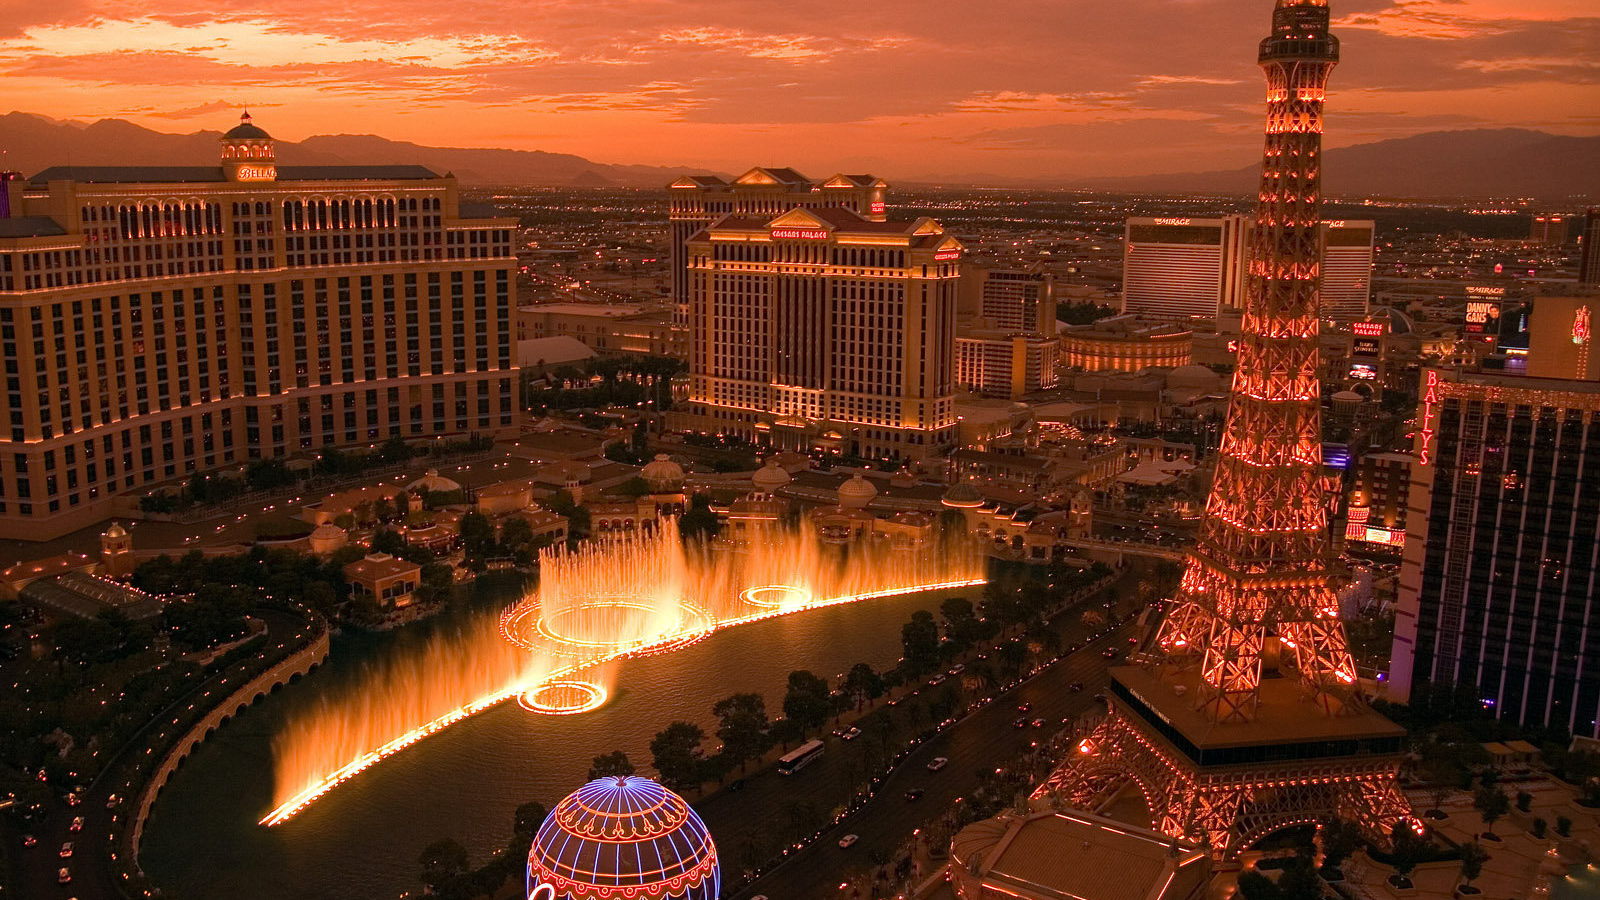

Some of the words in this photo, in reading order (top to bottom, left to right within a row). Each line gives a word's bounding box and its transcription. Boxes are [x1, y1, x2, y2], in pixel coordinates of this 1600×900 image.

[1158, 217, 1191, 226] MIRAGE
[772, 230, 800, 238] CAESARS
[801, 231, 827, 239] PALACE
[1469, 286, 1505, 294] MIRAGE
[1466, 302, 1493, 313] DANNY
[1466, 312, 1487, 323] GANS
[1353, 322, 1383, 330] CAESARS
